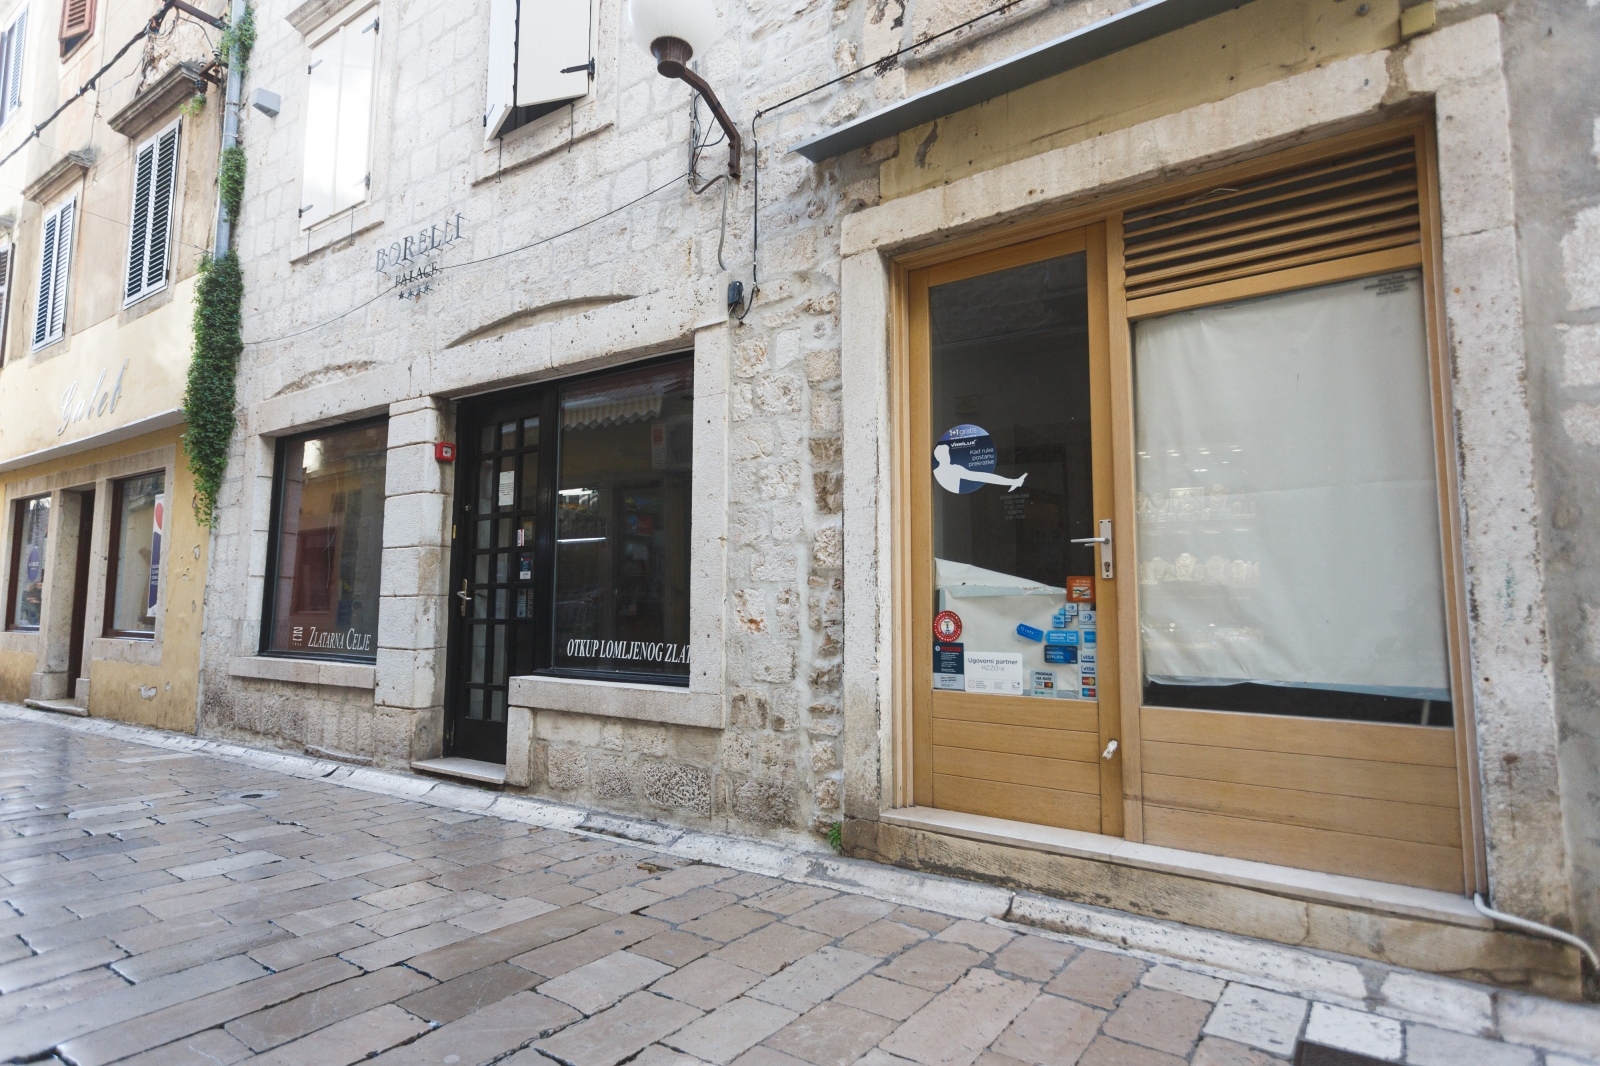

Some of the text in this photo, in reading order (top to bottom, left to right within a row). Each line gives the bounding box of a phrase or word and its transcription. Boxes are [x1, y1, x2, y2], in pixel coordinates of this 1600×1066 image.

[374, 212, 461, 272] BORELLI
[959, 427, 978, 436] gratis
[968, 459, 995, 468] prekratke
[567, 638, 599, 658] OTKUP
[600, 640, 664, 662] LOMLJENOG
